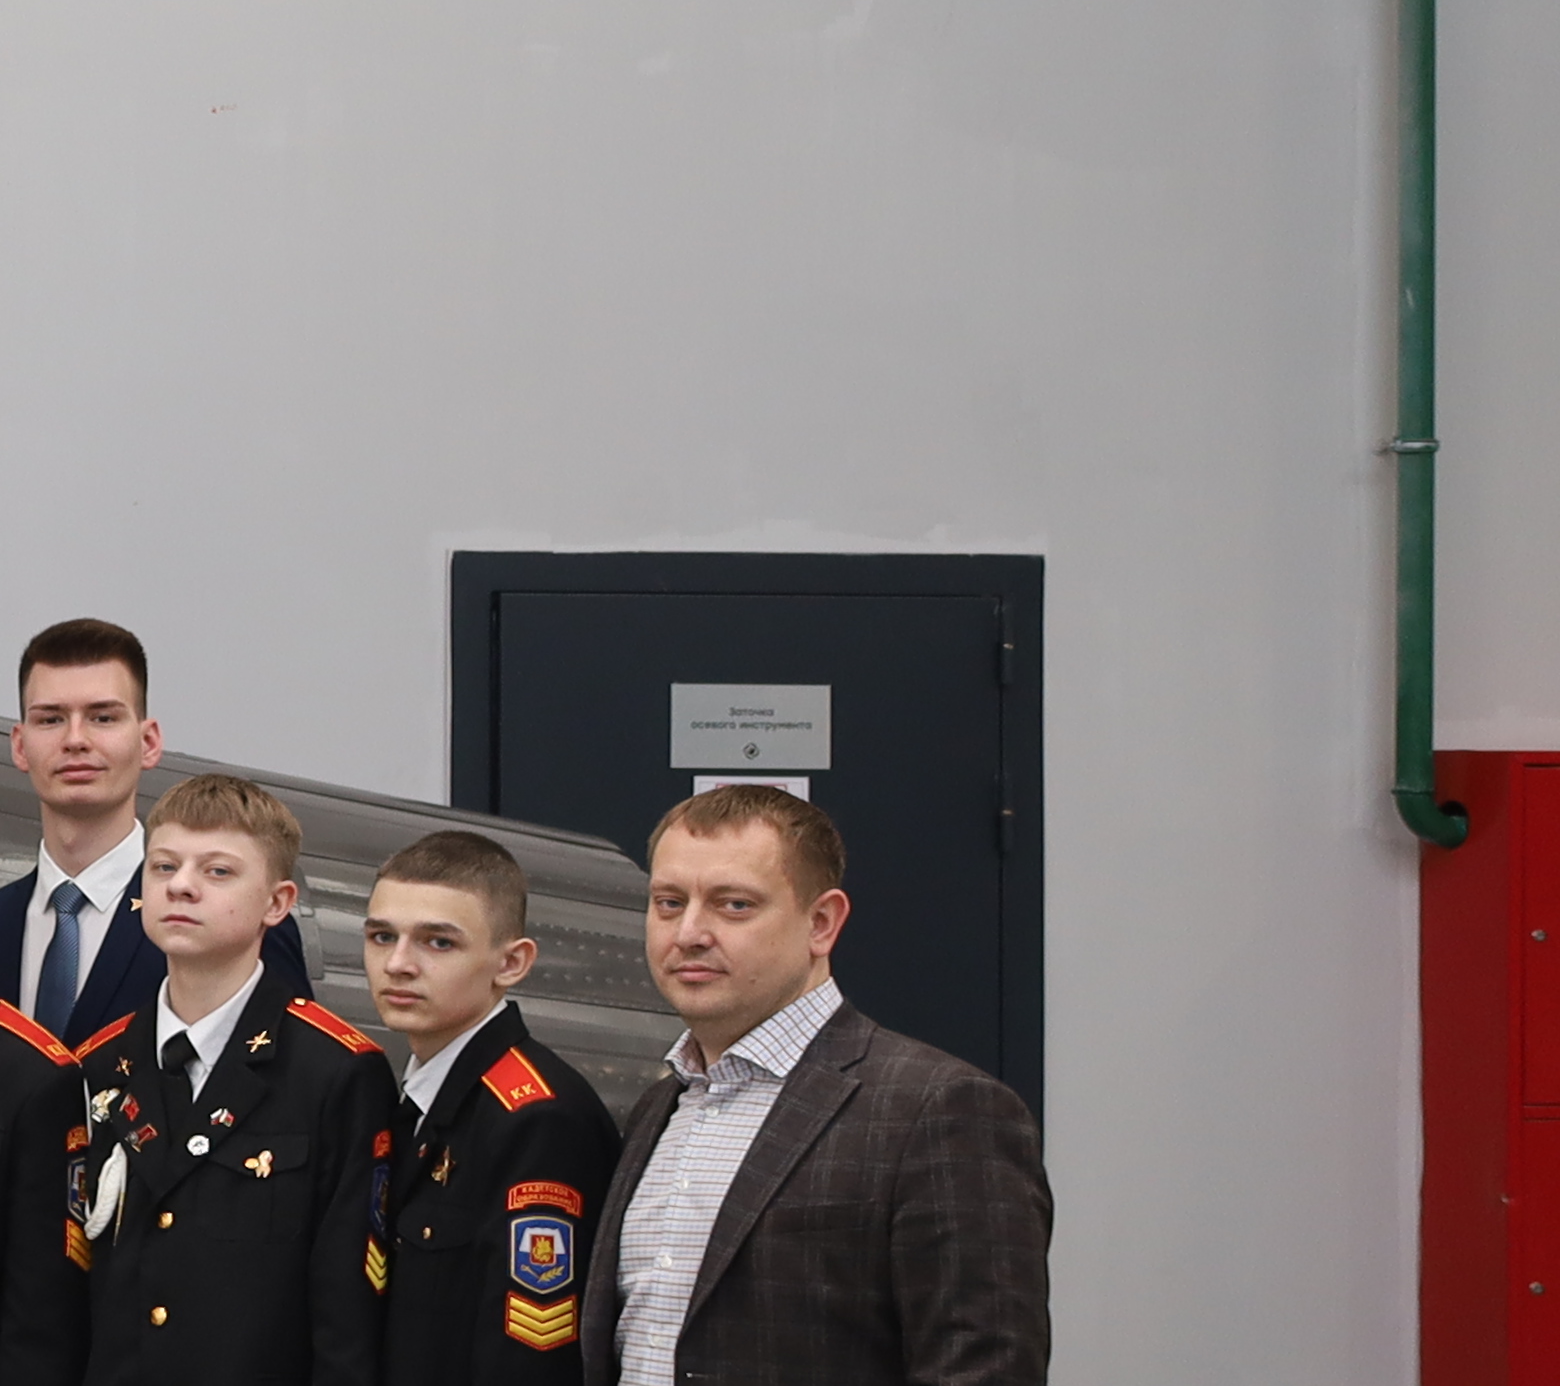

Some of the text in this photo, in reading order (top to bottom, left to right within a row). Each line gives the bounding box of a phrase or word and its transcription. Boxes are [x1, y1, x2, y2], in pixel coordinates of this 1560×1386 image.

[728, 706, 775, 718] Заточка
[690, 720, 812, 731] осевого инструмента
[509, 1082, 538, 1101] КК
